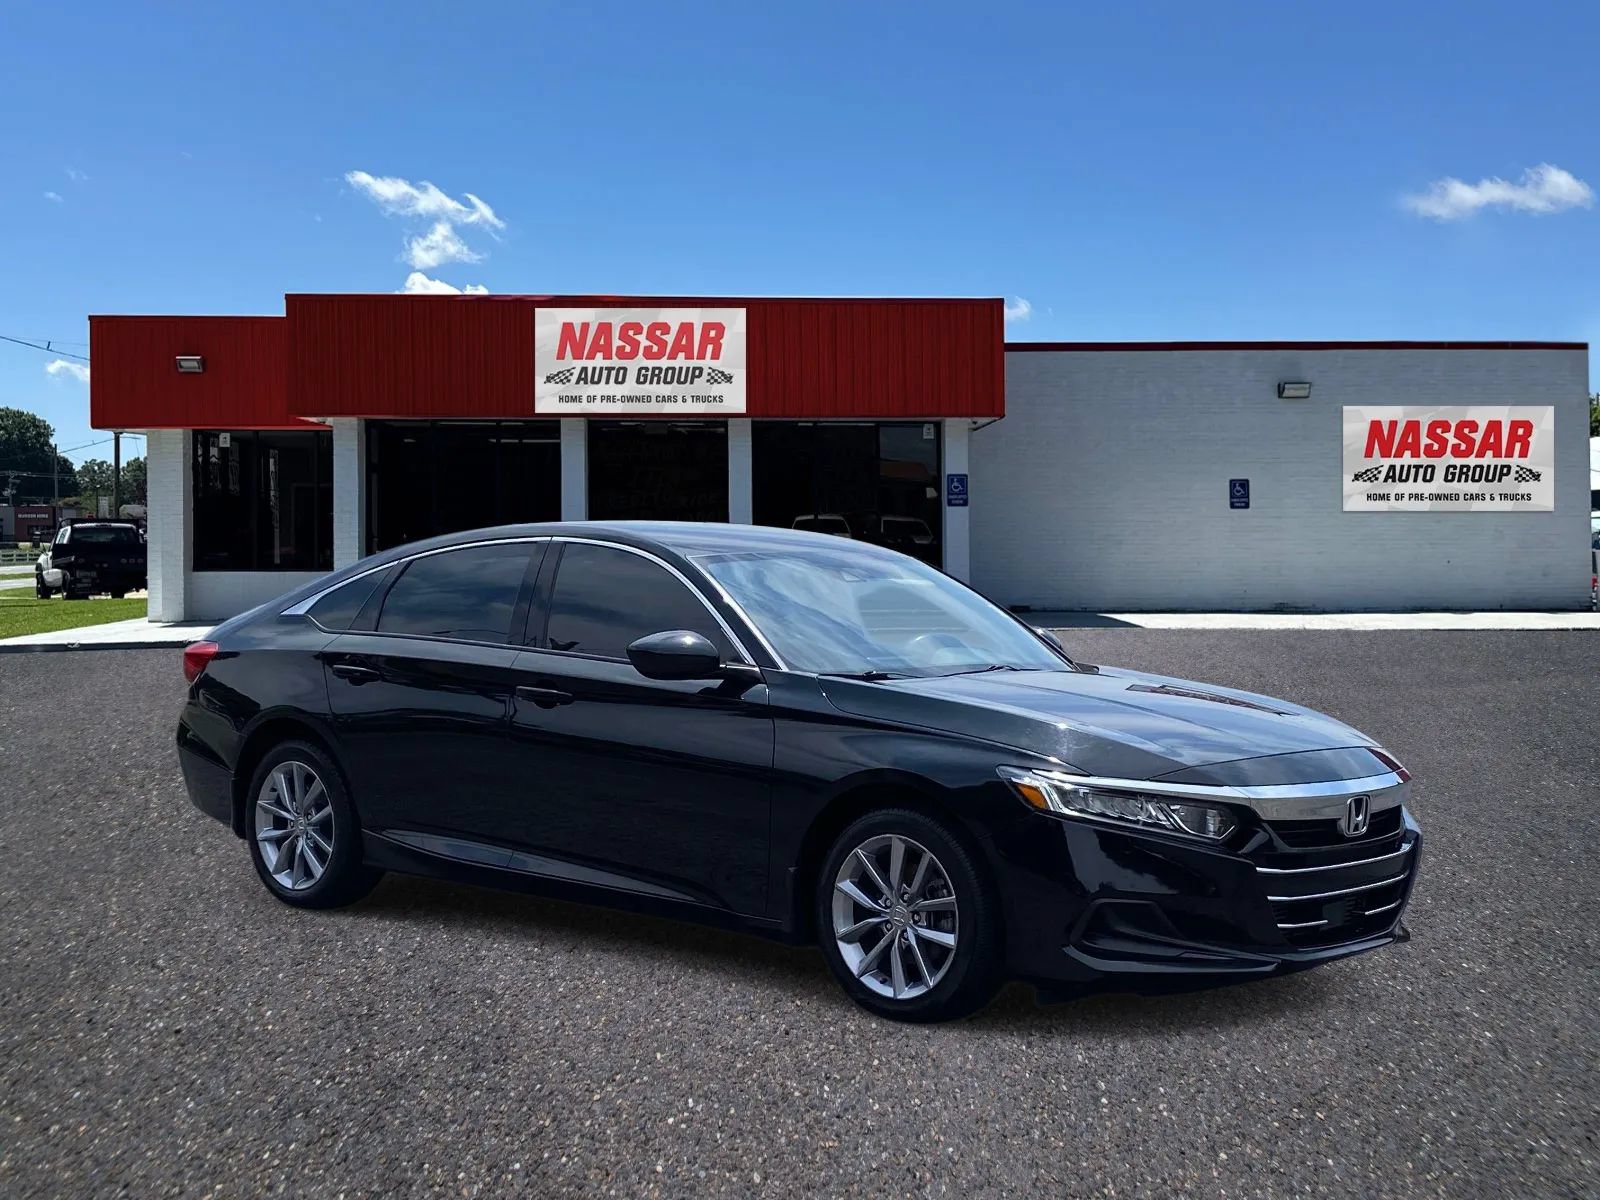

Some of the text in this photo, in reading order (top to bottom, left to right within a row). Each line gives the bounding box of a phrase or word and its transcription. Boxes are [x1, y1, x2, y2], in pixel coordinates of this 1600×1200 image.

[556, 322, 726, 360] NASSAR
[575, 366, 704, 385] AUTO GROUP
[558, 395, 724, 404] HOME OF PRE-OWNED CARS & TRUCKS
[1364, 420, 1534, 458] NASSAR
[1383, 464, 1512, 483] AUTO GROUP
[1366, 493, 1532, 502] HOME OF PRE-OWNED CARS & TRUCKS
